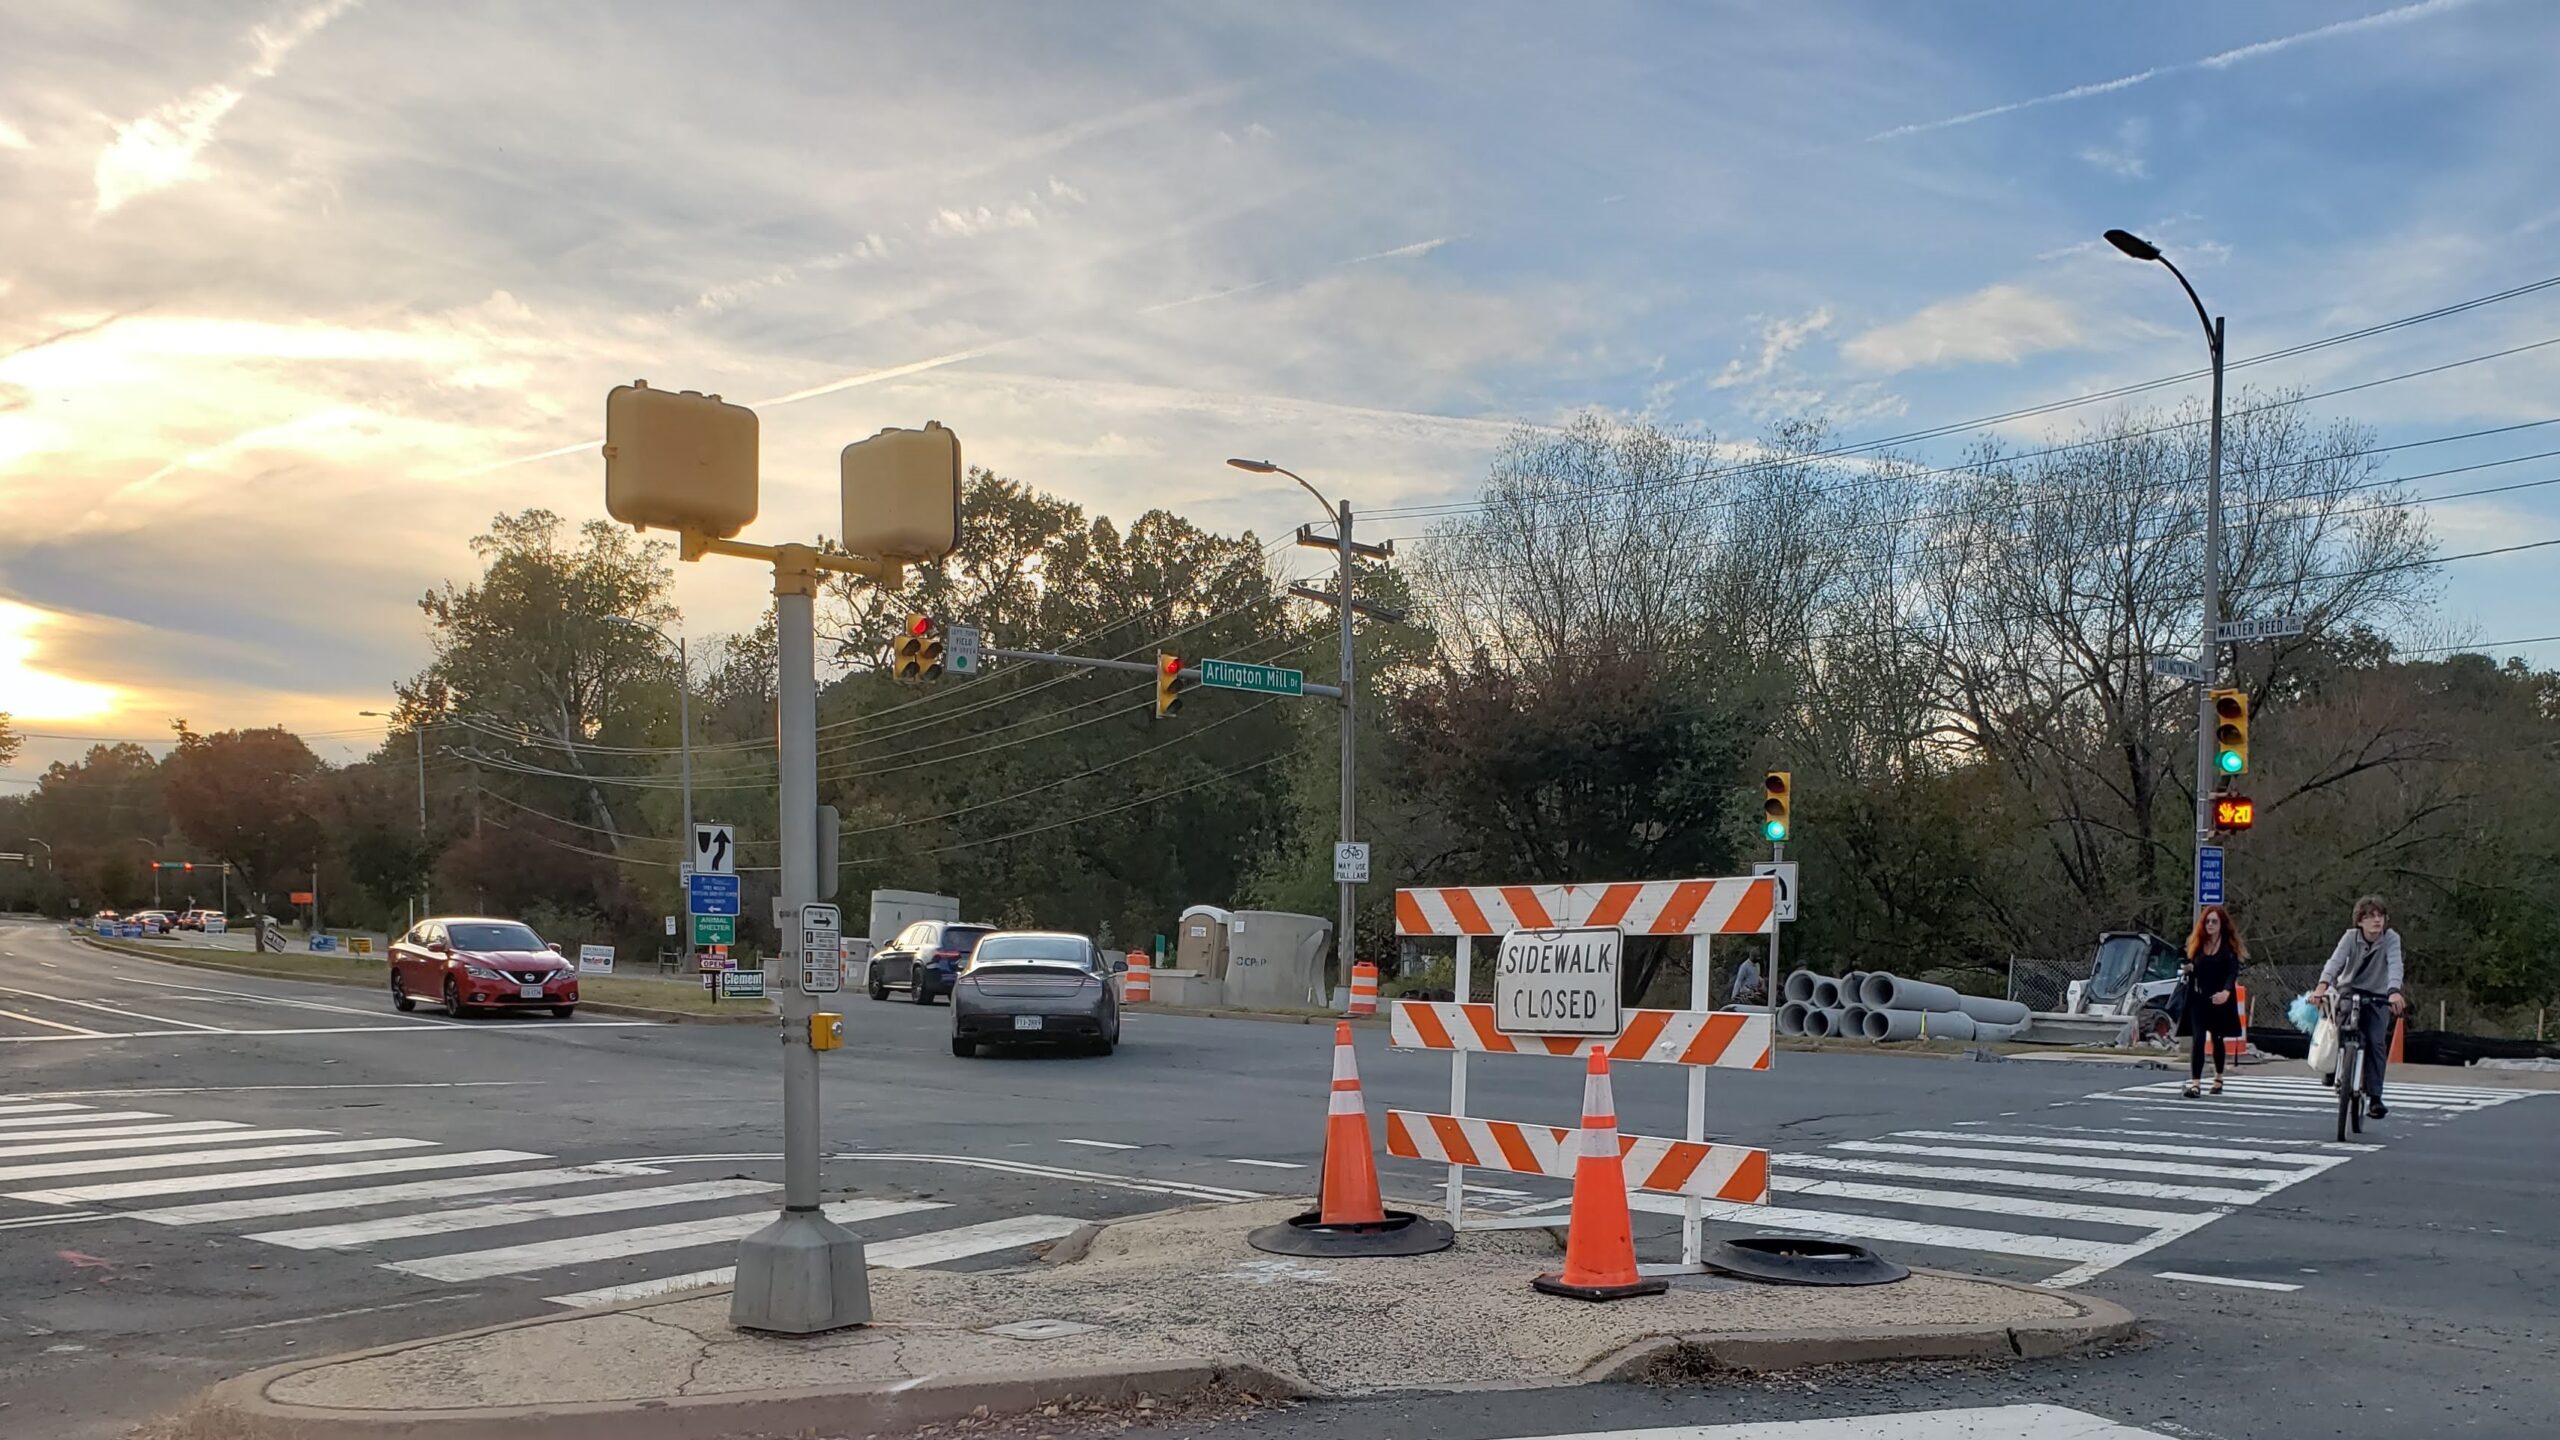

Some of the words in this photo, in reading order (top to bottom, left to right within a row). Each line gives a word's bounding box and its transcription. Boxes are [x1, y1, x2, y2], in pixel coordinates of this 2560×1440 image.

[2218, 622, 2254, 638] WALTER
[2258, 620, 2283, 634] REED
[956, 636, 973, 646] YIELD
[1206, 663, 1262, 687] Arlington
[1266, 670, 1287, 688] Mill
[1290, 678, 1298, 688] Dr
[2234, 805, 2253, 824] 20
[1338, 863, 1351, 871] MAY
[1355, 863, 1367, 871] USE
[1336, 871, 1350, 880] FULL
[1352, 872, 1368, 880] LANE
[2202, 871, 2220, 880] PUBLIC
[2202, 881, 2220, 890] LIBRARY
[700, 916, 729, 924] ANIMAL
[703, 960, 725, 968] OPEN
[1506, 944, 1612, 974] SIDEWALK
[724, 973, 763, 985] Clement
[1514, 989, 1597, 1019] CLOSED
